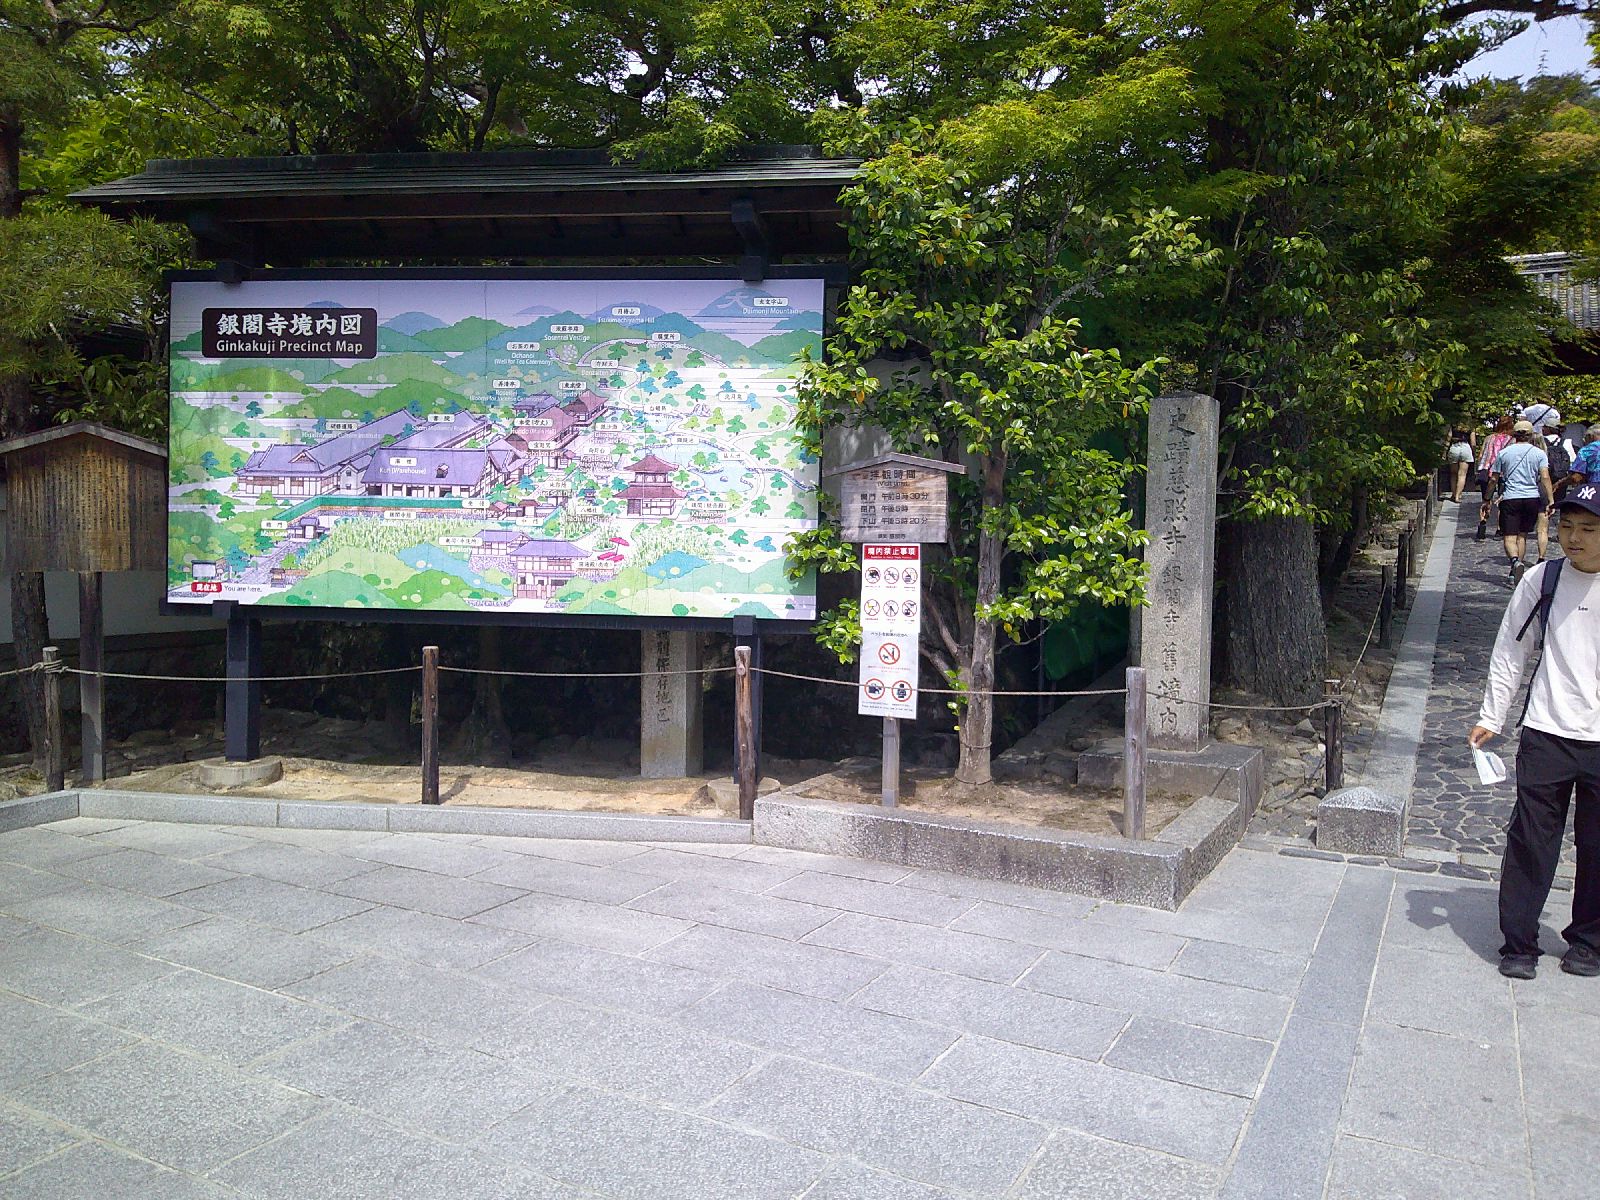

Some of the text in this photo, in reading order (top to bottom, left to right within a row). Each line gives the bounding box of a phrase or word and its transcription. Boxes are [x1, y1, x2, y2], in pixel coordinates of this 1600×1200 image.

[758, 298, 783, 306] 大文字山
[216, 312, 363, 337] 銀閣寺境内図
[216, 339, 363, 354] Ginkakuji Precinct Map
[870, 469, 916, 480] 拝観時間
[867, 547, 916, 556] 境内禁止事項
